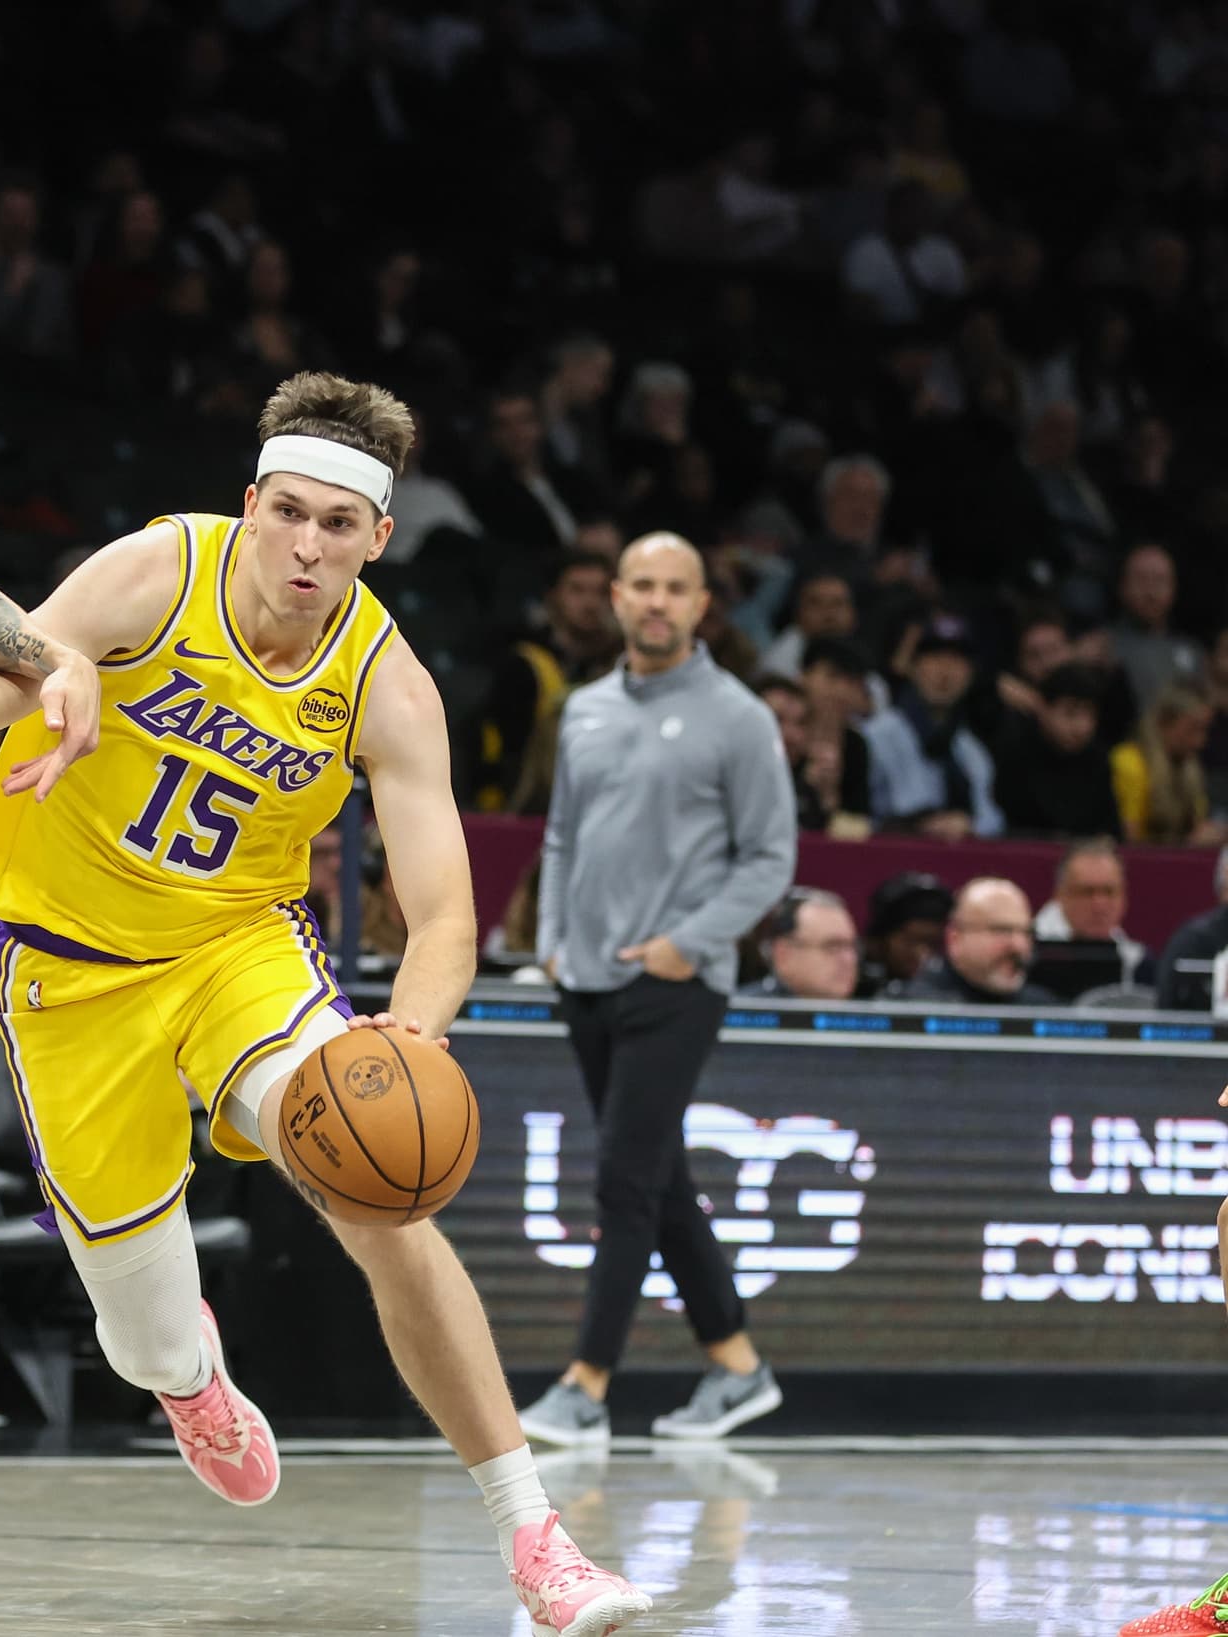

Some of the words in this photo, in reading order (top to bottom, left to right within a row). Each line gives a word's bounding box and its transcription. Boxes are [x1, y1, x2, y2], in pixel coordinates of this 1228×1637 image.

[116, 668, 336, 793] LAKERS
[302, 698, 346, 722] bibigo
[119, 752, 261, 879] 15
